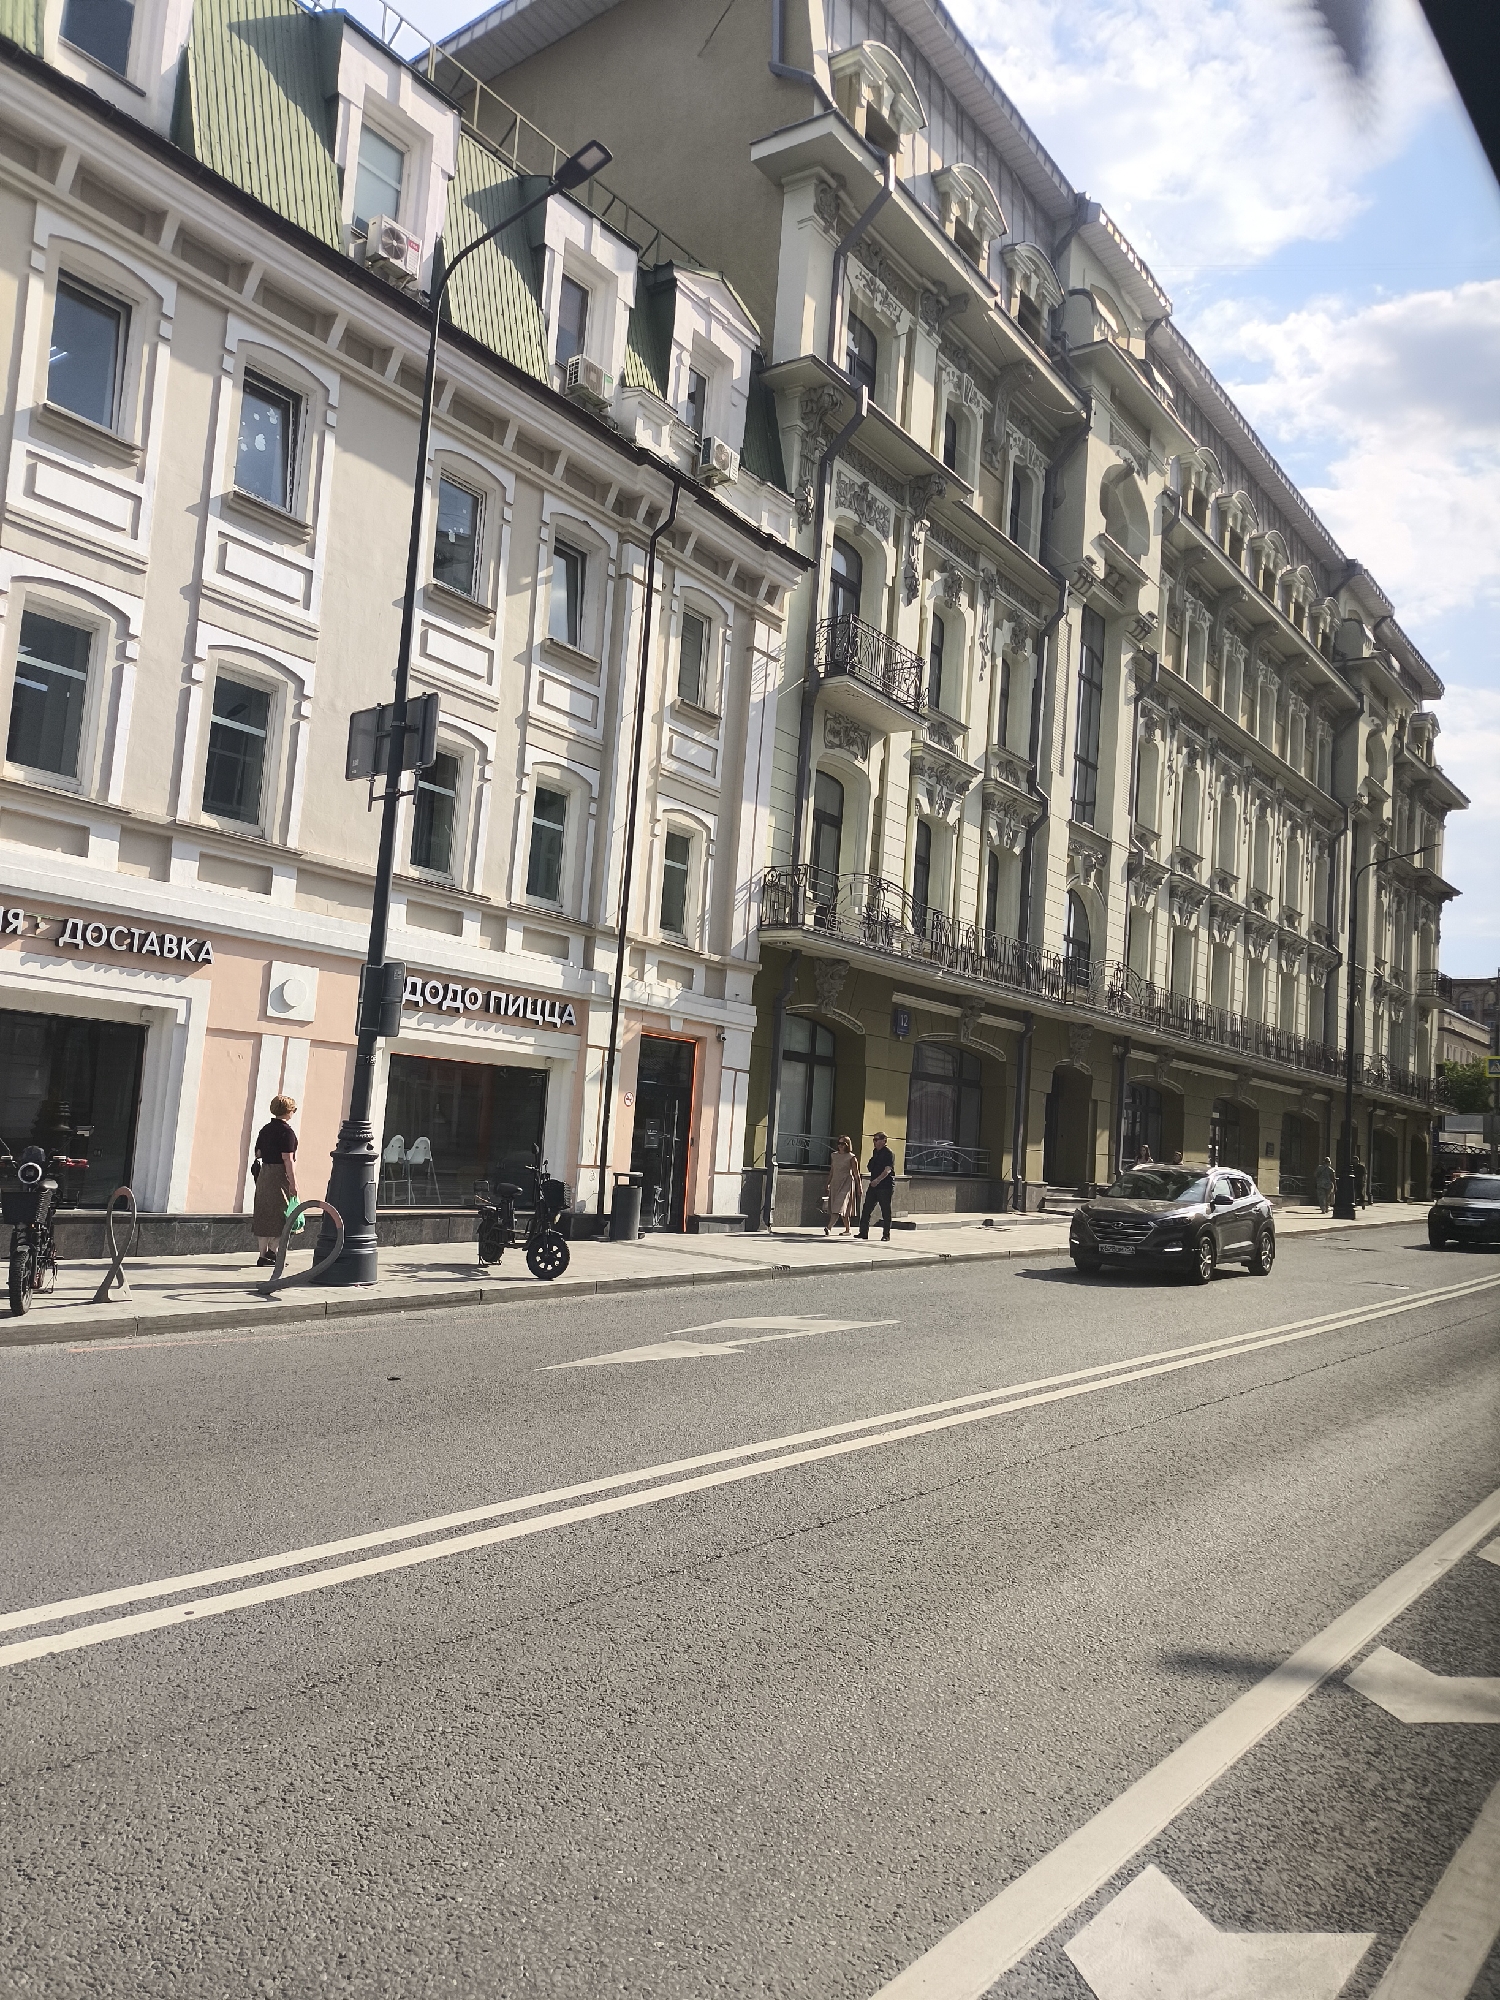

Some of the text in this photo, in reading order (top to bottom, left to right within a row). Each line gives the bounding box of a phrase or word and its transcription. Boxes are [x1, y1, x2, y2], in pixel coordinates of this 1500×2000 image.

[58, 918, 215, 964] ДОСТАВКА
[403, 976, 577, 1028] ДОДО ПИЦЦА
[900, 1014, 908, 1027] 12
